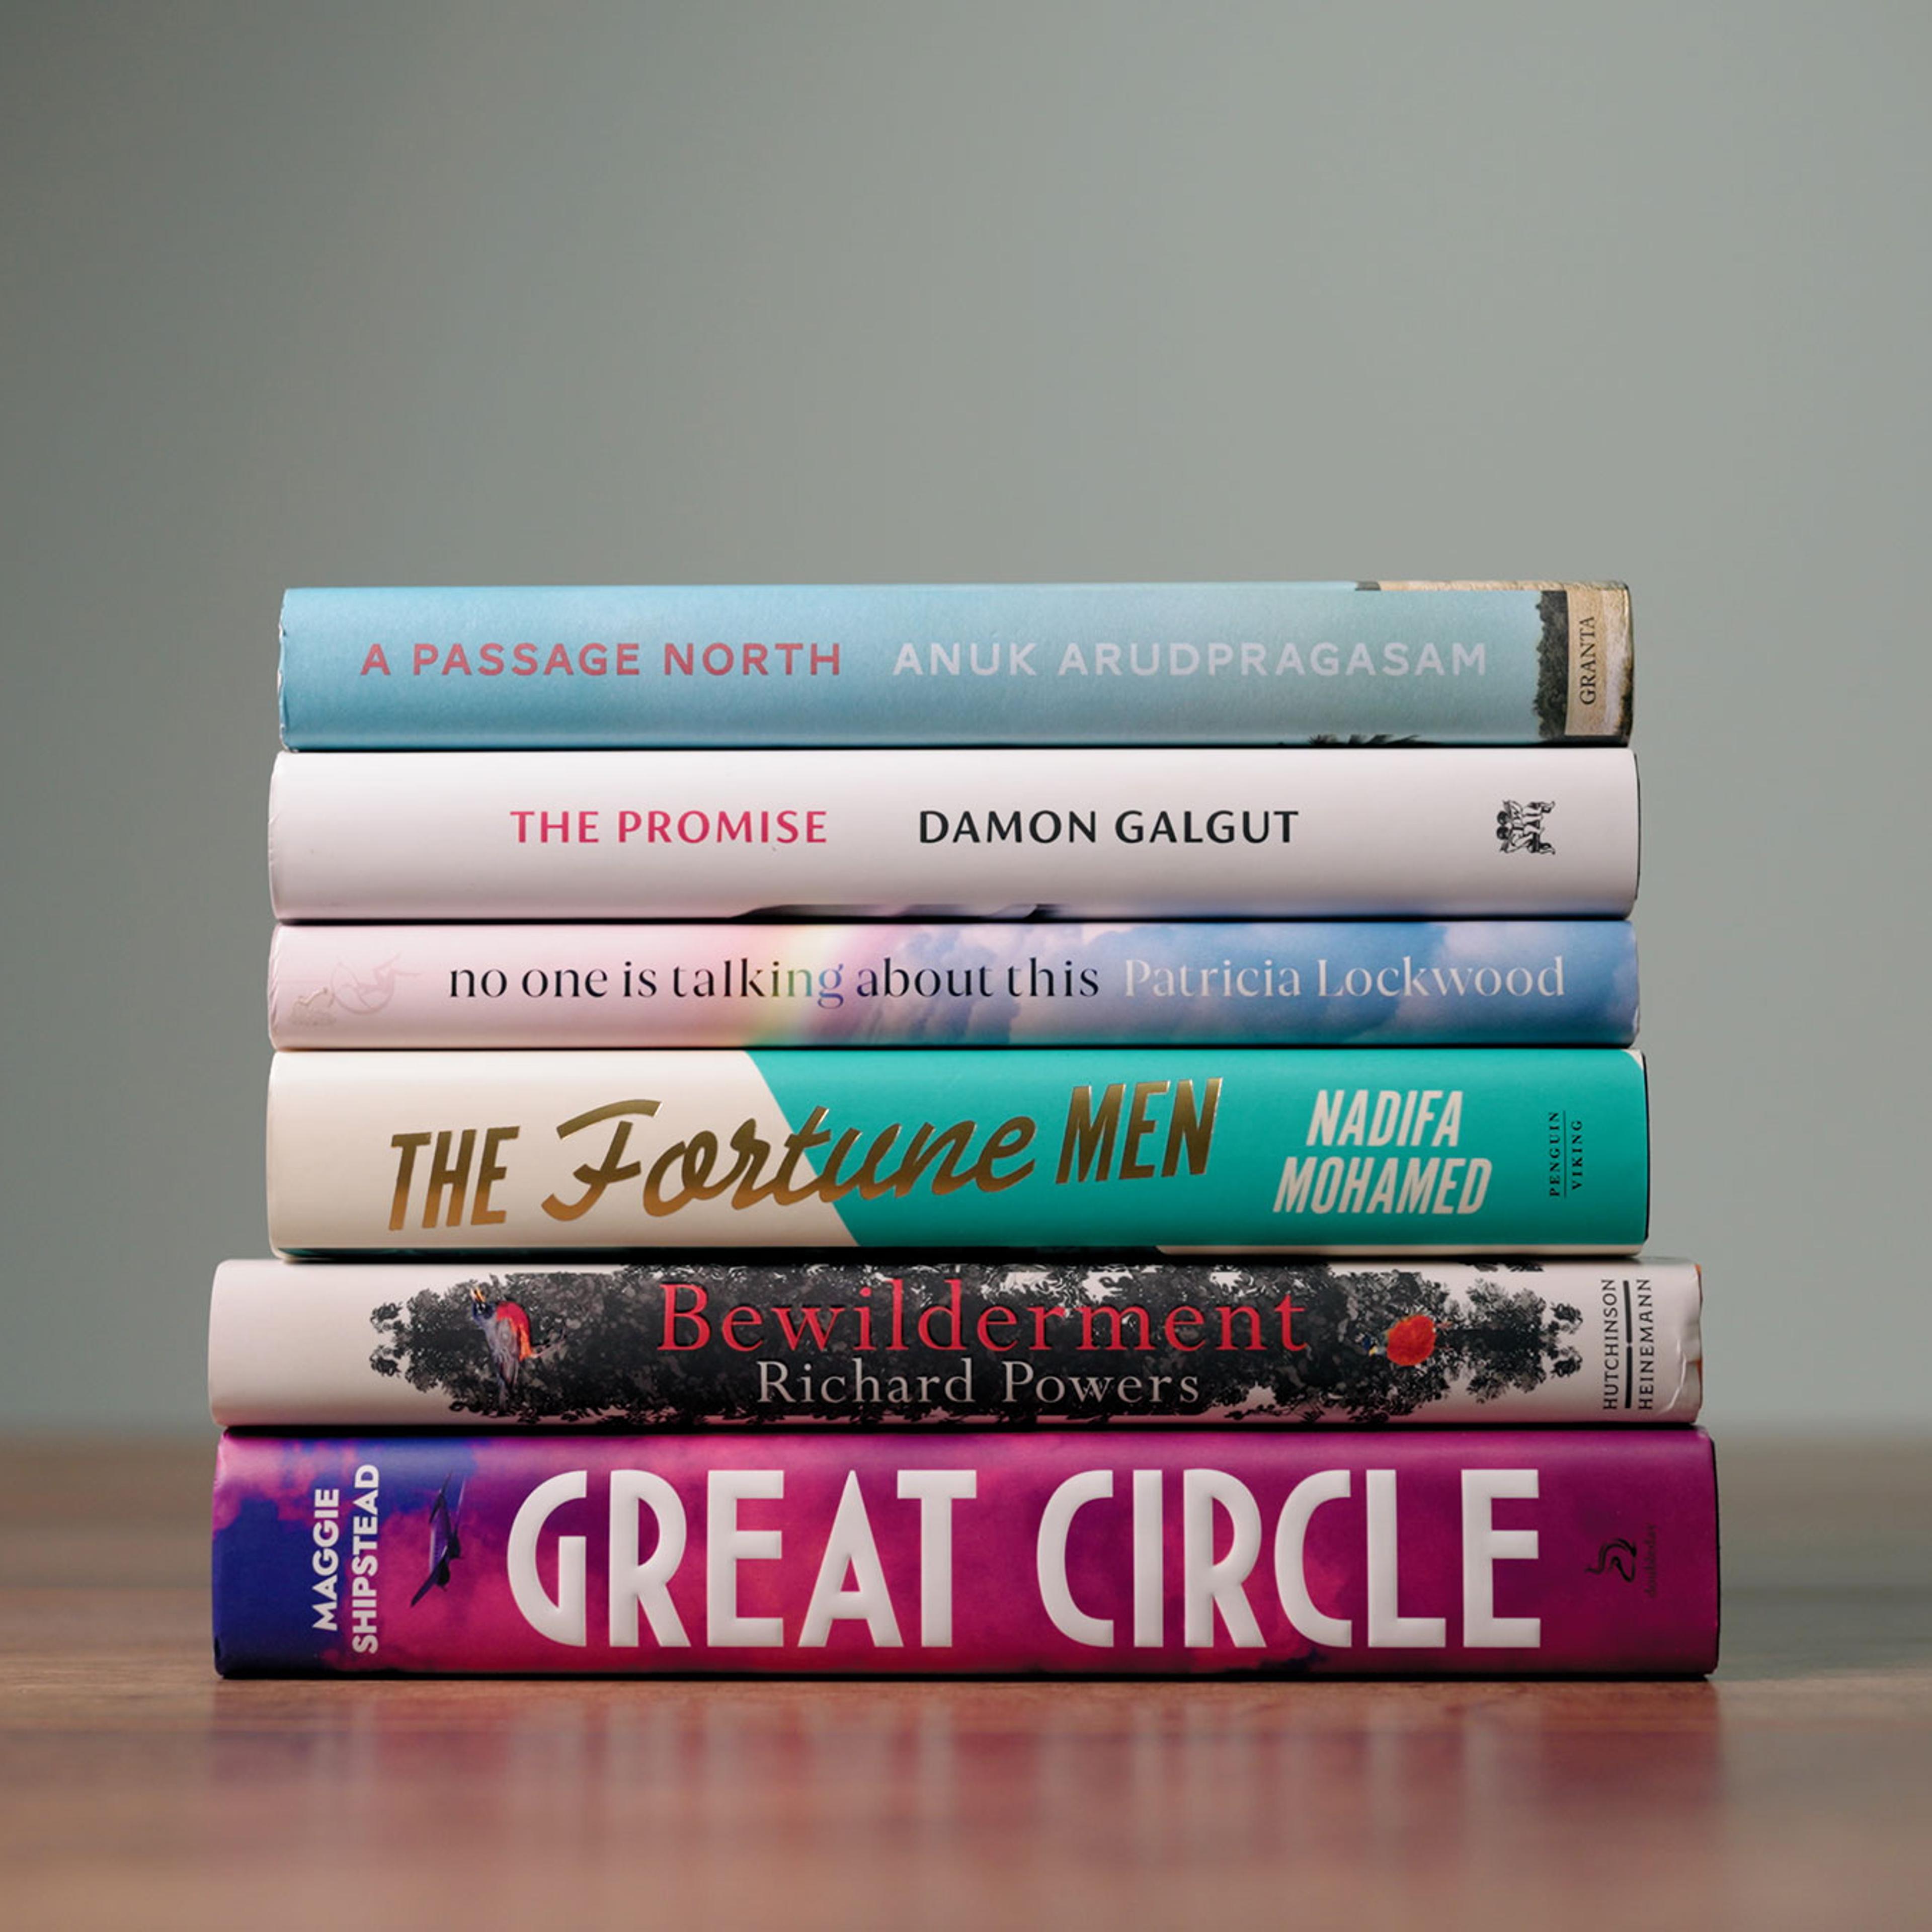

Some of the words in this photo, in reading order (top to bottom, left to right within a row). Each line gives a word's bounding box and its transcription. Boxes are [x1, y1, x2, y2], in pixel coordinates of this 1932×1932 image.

[360, 643, 390, 676] A
[413, 642, 641, 676] PASSAGE
[664, 642, 841, 675] NORTH
[893, 642, 1037, 677] ANUK
[1058, 642, 1487, 676] ARUDPRAGASAM
[1579, 616, 1596, 704] GRANTA
[510, 810, 599, 843] THE
[618, 809, 828, 844] PROMISE
[920, 810, 1097, 843] DAMON
[1114, 809, 1299, 844] GALGUT
[449, 962, 507, 998] no
[521, 962, 608, 999] one
[622, 960, 658, 998] is
[672, 956, 844, 1008] talking
[856, 957, 992, 998] about
[1006, 956, 1099, 998] this
[1123, 957, 1302, 997] Patricia
[1316, 956, 1565, 997] Lockwood
[388, 1125, 520, 1231] THE
[541, 1099, 1036, 1221] Fortune
[1056, 1077, 1223, 1184] MEN
[1306, 1090, 1464, 1146] NADIFA
[1549, 1112, 1560, 1196] PENGUIN
[1571, 1121, 1583, 1190] VIKING
[1273, 1156, 1492, 1215] MOHAMED
[656, 1278, 1309, 1352] Bewilderment
[1601, 1279, 1619, 1410] HUTCHINSON
[1636, 1279, 1654, 1410] HEINEMANN
[757, 1357, 976, 1405] Richard
[1001, 1358, 1200, 1405] Powers
[312, 1489, 339, 1631] MAGGIE
[352, 1465, 379, 1654] SHIPSTEAD
[507, 1469, 978, 1648] GREAT
[1035, 1468, 1542, 1648] CIRCLE
